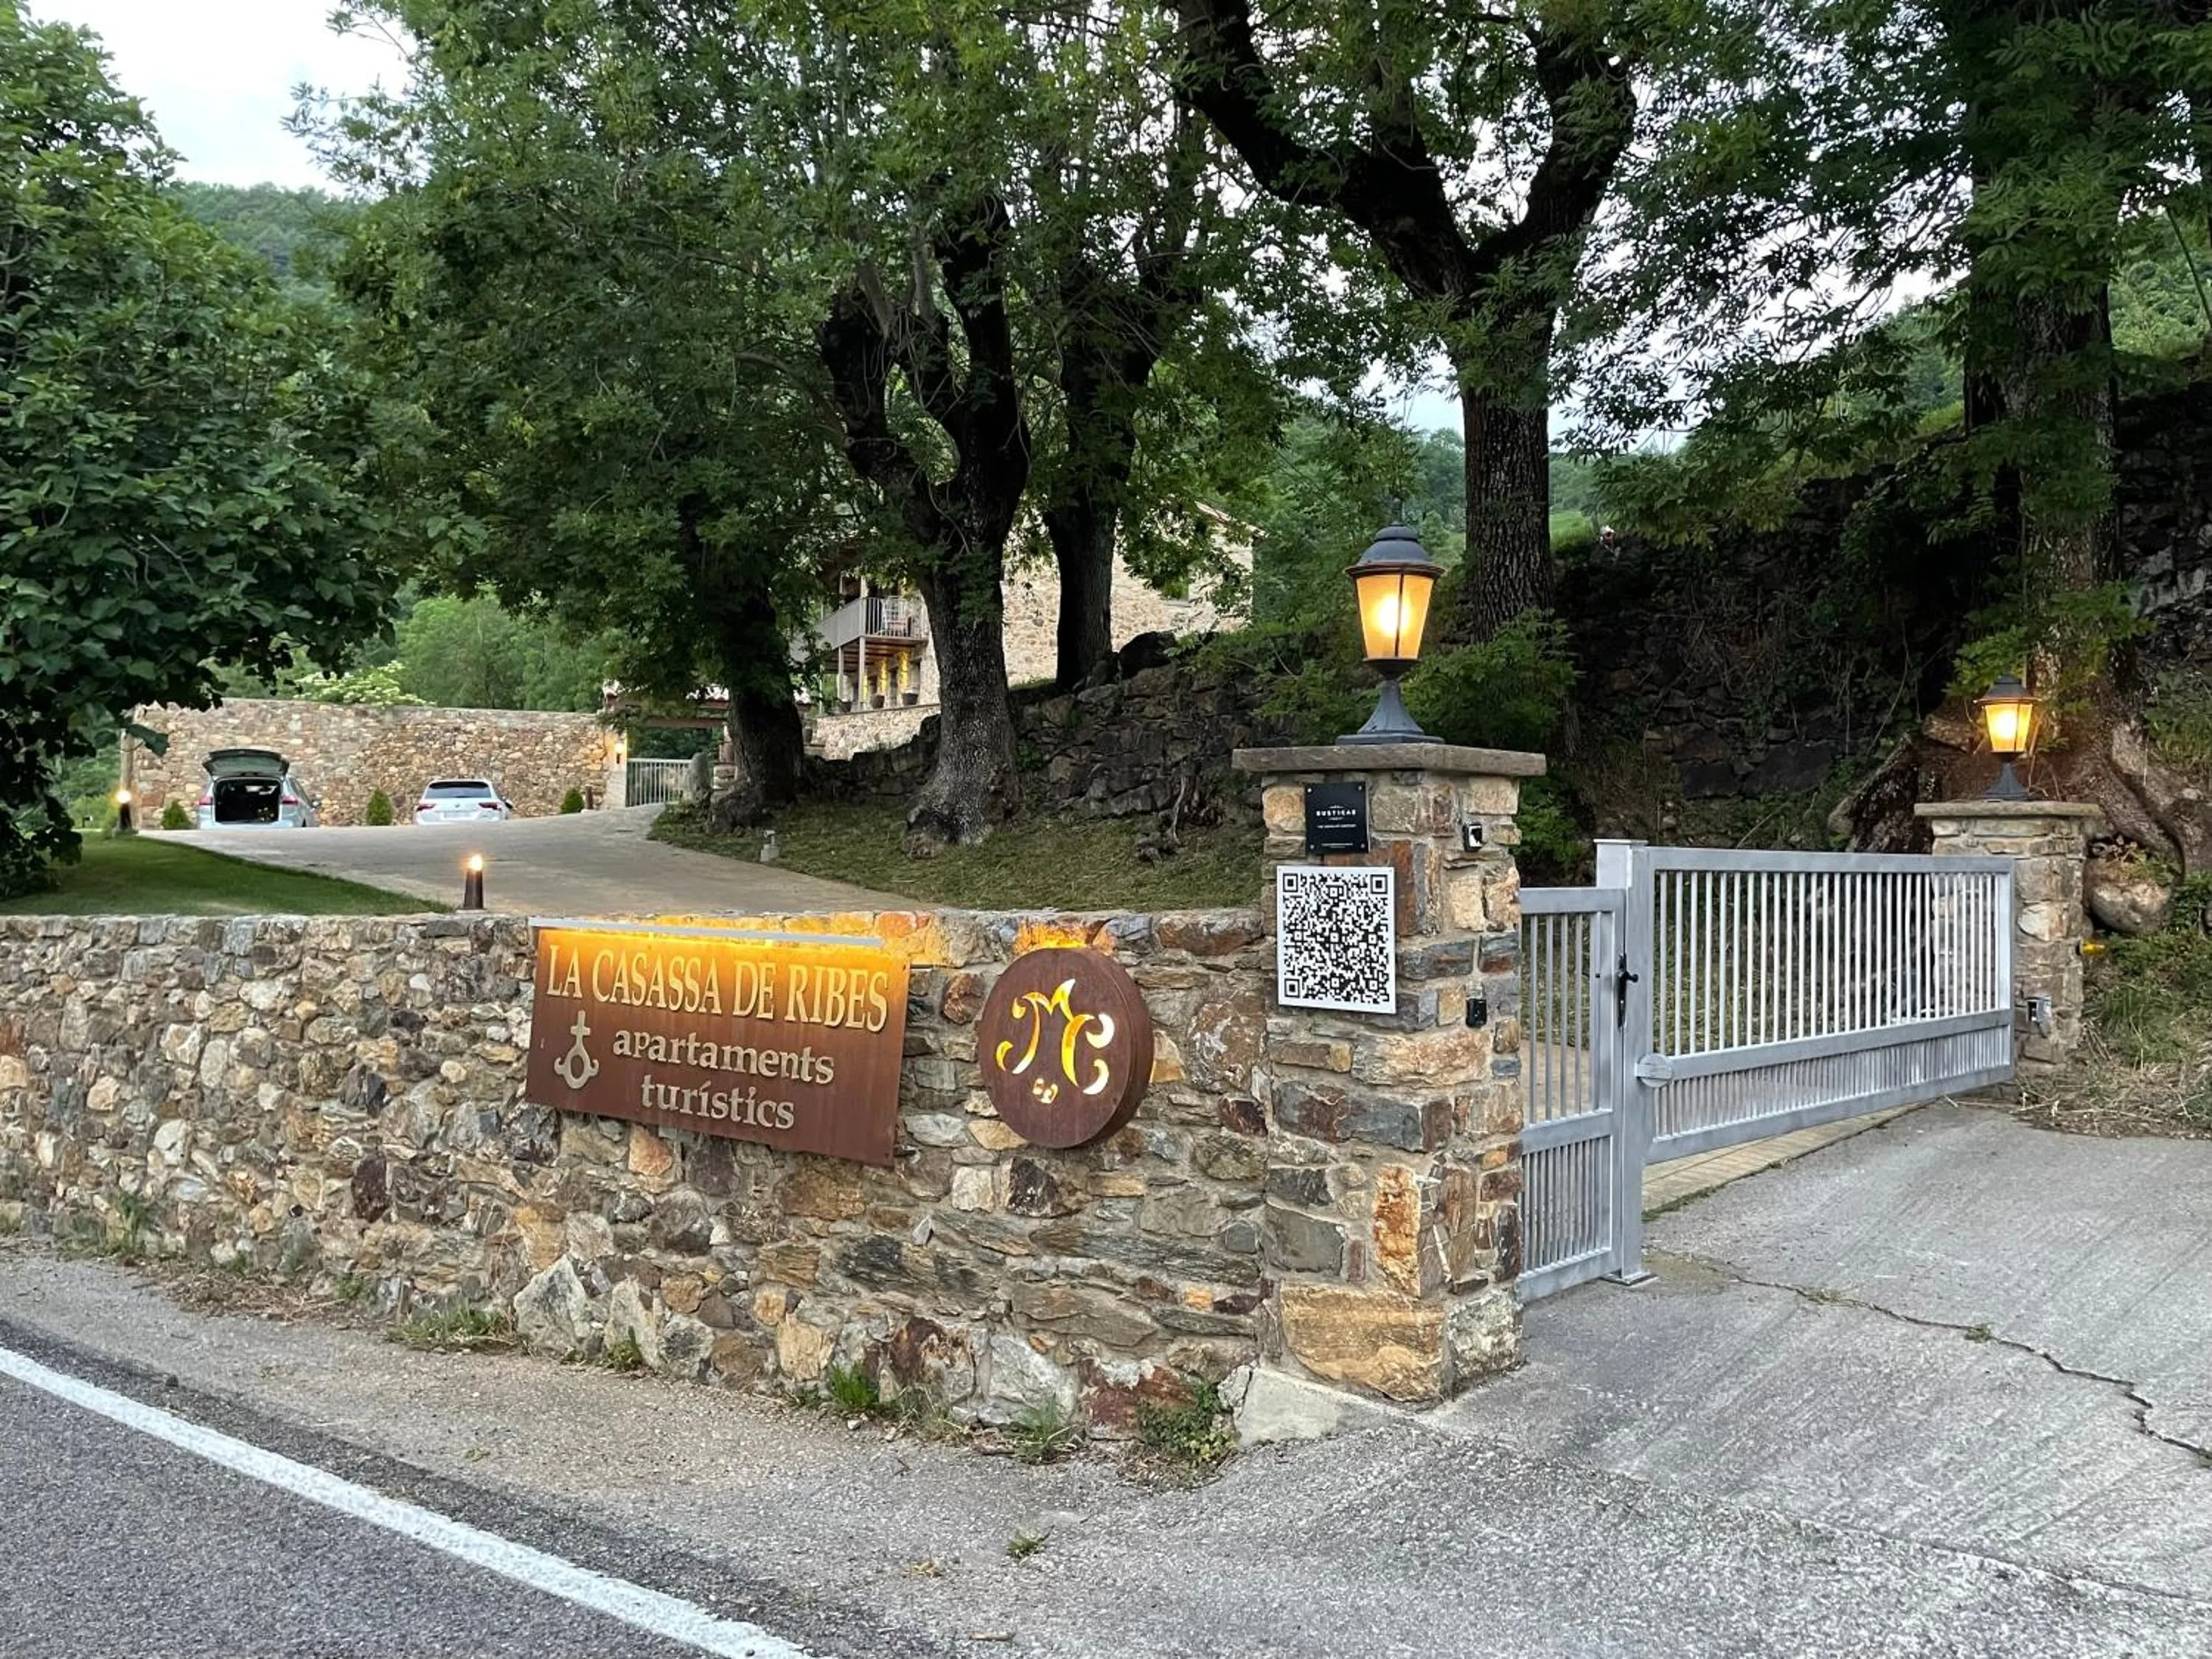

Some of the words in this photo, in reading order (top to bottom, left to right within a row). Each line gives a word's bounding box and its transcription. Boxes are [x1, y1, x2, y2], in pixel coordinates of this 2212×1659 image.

[546, 944, 582, 998] LA
[592, 949, 722, 1015] CASASSA
[732, 960, 776, 1019] DE
[783, 964, 889, 1033] RIBES
[613, 1029, 835, 1085] apartaments
[640, 1074, 795, 1130] turístics
